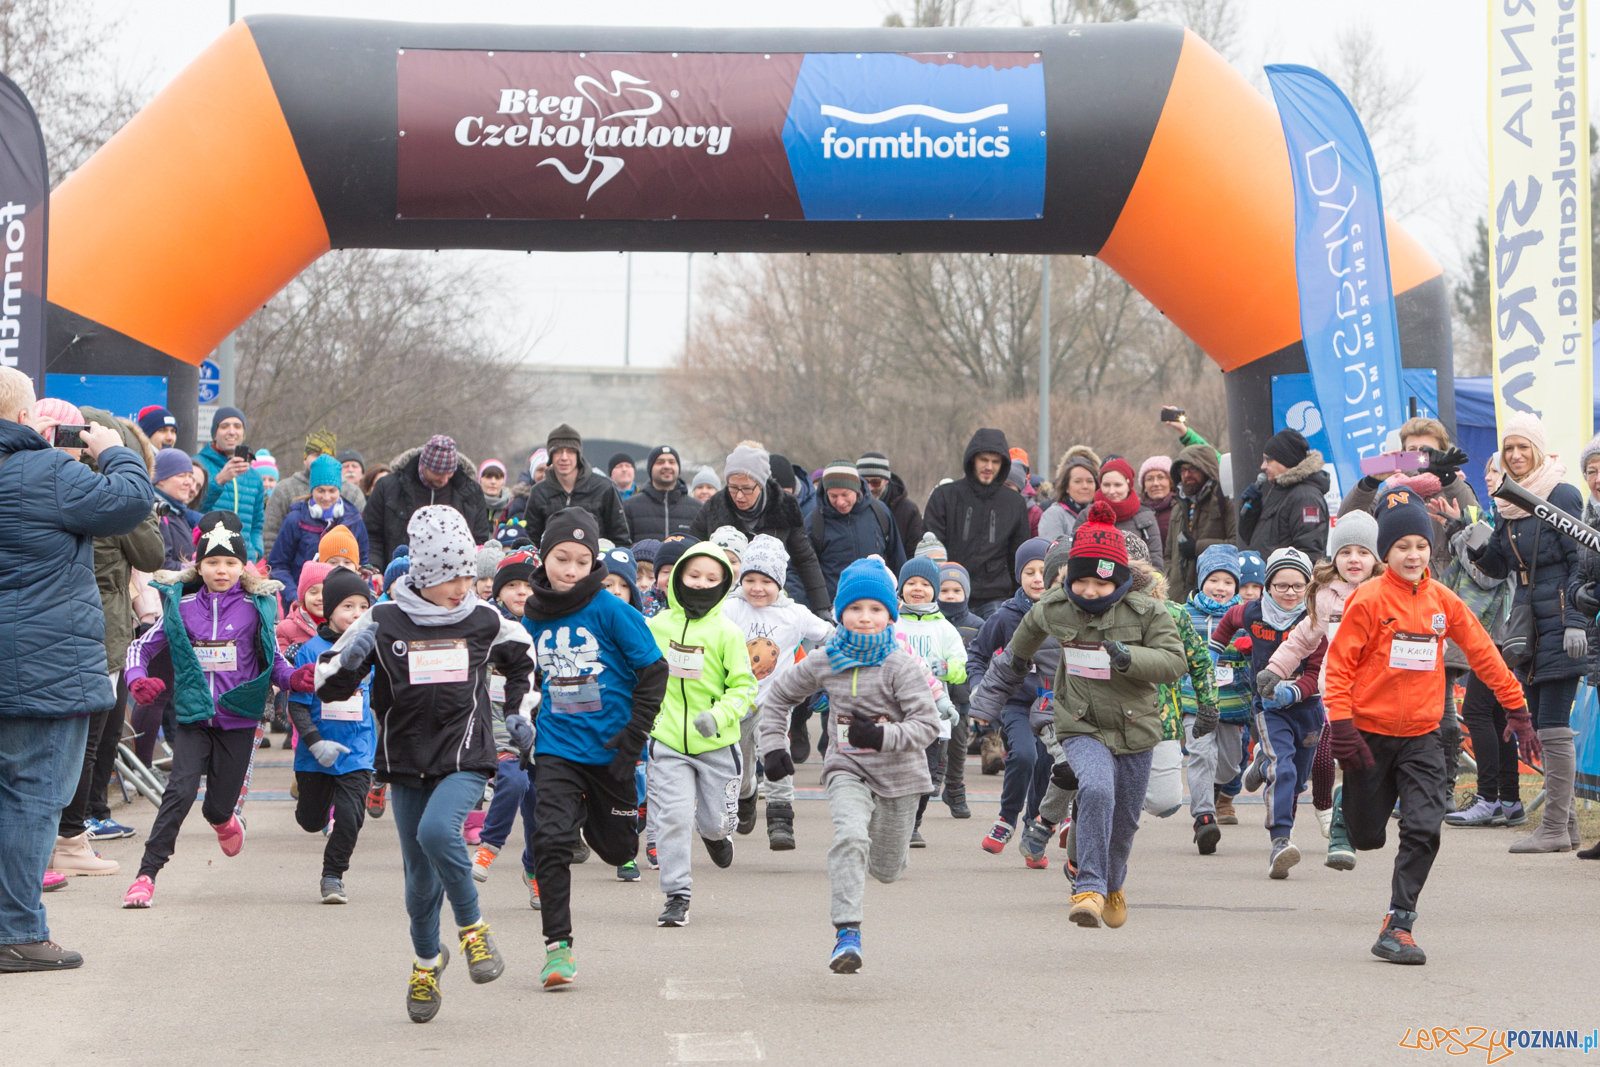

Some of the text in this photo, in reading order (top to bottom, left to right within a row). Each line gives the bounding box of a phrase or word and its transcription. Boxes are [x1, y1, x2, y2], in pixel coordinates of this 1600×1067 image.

[496, 88, 583, 121] Bieg
[454, 115, 732, 155] Czekoladowy
[820, 126, 1010, 158] formthotics
[1386, 491, 1410, 509] N
[1533, 504, 1600, 553] GARMIN
[747, 622, 778, 638] MAX
[1407, 647, 1434, 657] KACPER
